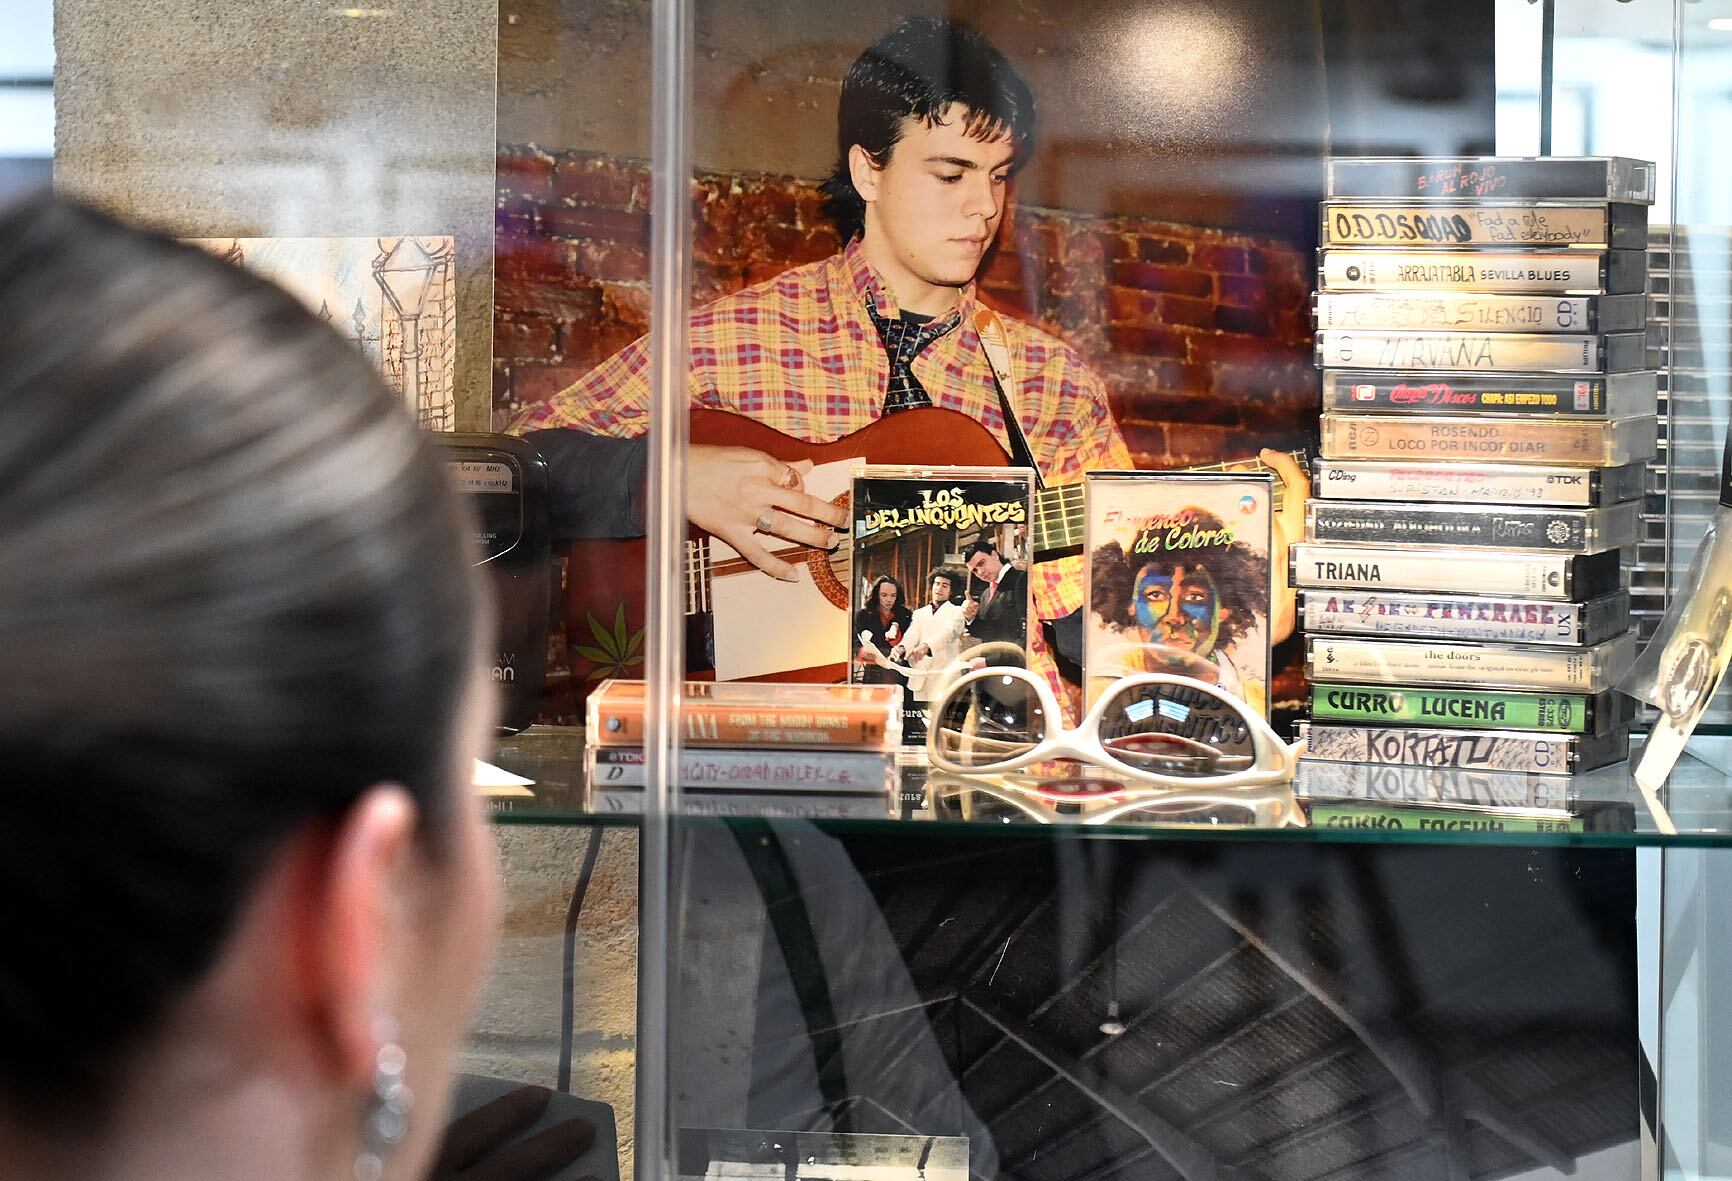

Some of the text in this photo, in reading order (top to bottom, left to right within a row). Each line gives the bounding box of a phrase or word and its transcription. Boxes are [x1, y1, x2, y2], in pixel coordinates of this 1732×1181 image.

[1480, 270, 1525, 281] SEVILLA
[1528, 270, 1571, 281] BLUES
[1557, 300, 1572, 328] CD
[1378, 336, 1494, 368] NIRVANA
[1431, 426, 1499, 438] ROSENDO
[1389, 439, 1425, 450] LOCO
[1431, 440, 1458, 451] POR
[1328, 470, 1357, 482] CDing
[1554, 475, 1581, 485] TDK
[917, 486, 968, 509] LOS
[1134, 524, 1235, 553] de Colores
[1315, 562, 1381, 582] TRIANA
[1558, 613, 1572, 637] UX
[1446, 650, 1481, 661] doors
[1327, 690, 1506, 721] CURRO LUCENA
[1367, 730, 1497, 768] KORTATU
[1534, 740, 1550, 767] CD
[606, 766, 623, 780] D
